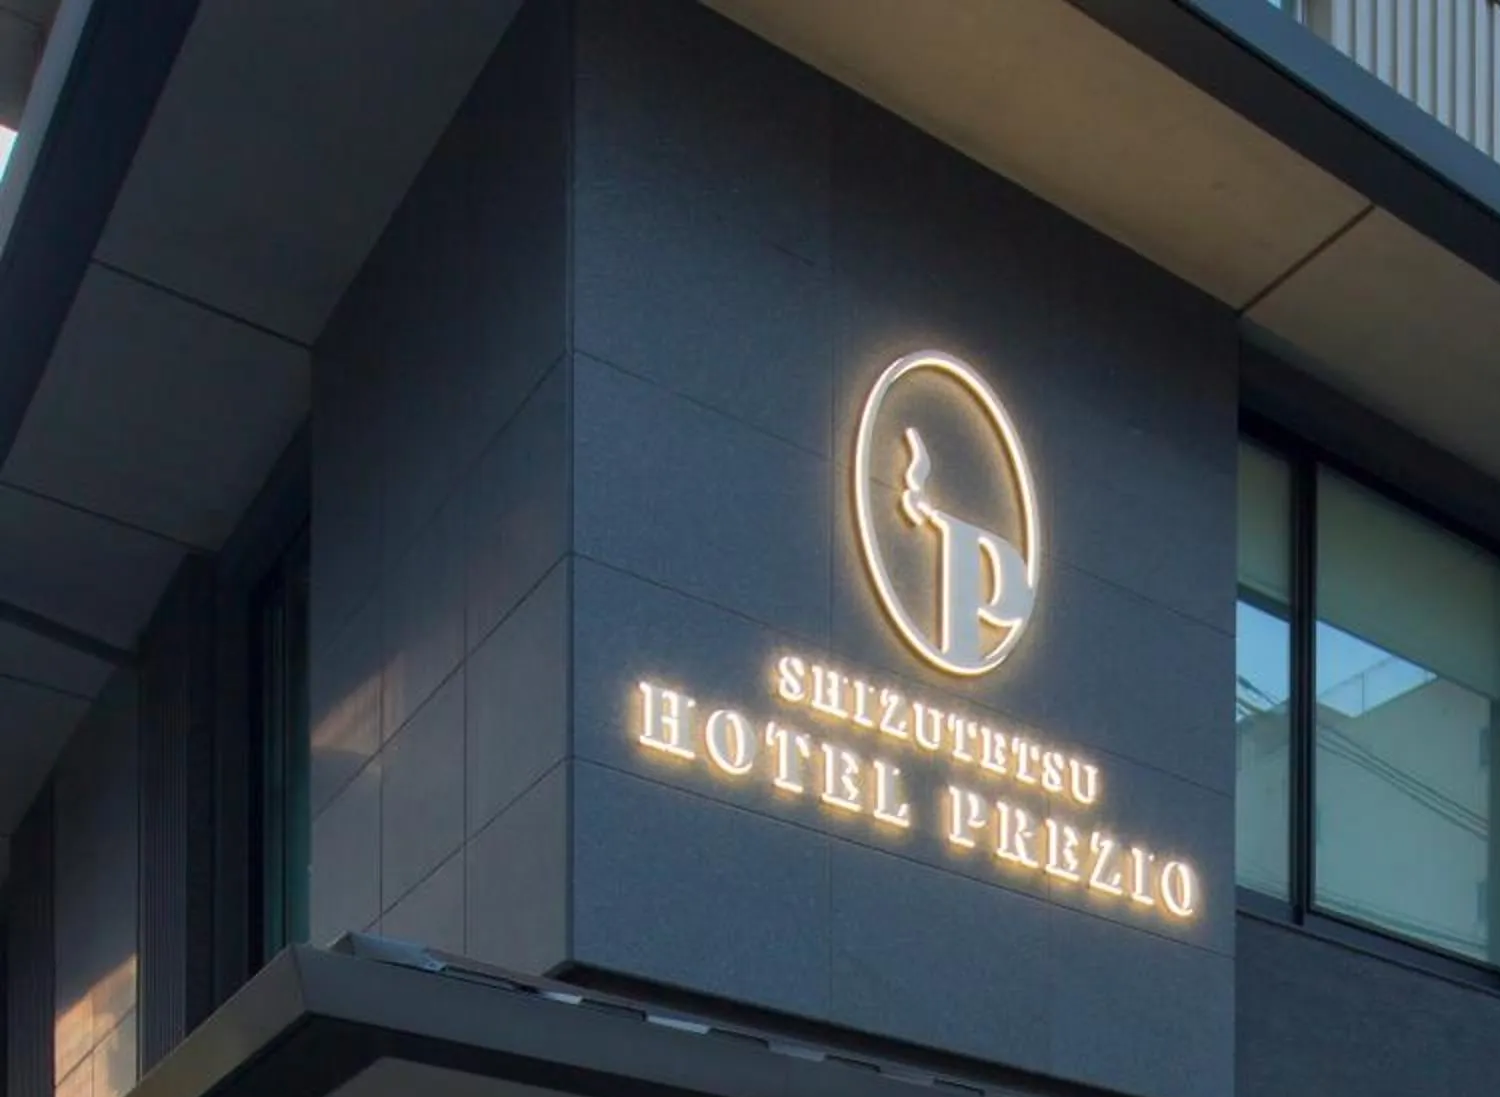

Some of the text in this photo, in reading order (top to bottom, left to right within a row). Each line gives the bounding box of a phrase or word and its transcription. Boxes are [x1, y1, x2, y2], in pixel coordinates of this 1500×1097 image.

[638, 680, 1199, 918] HOTEL PREZIO
[776, 654, 1100, 805] SHIZUTETSU
